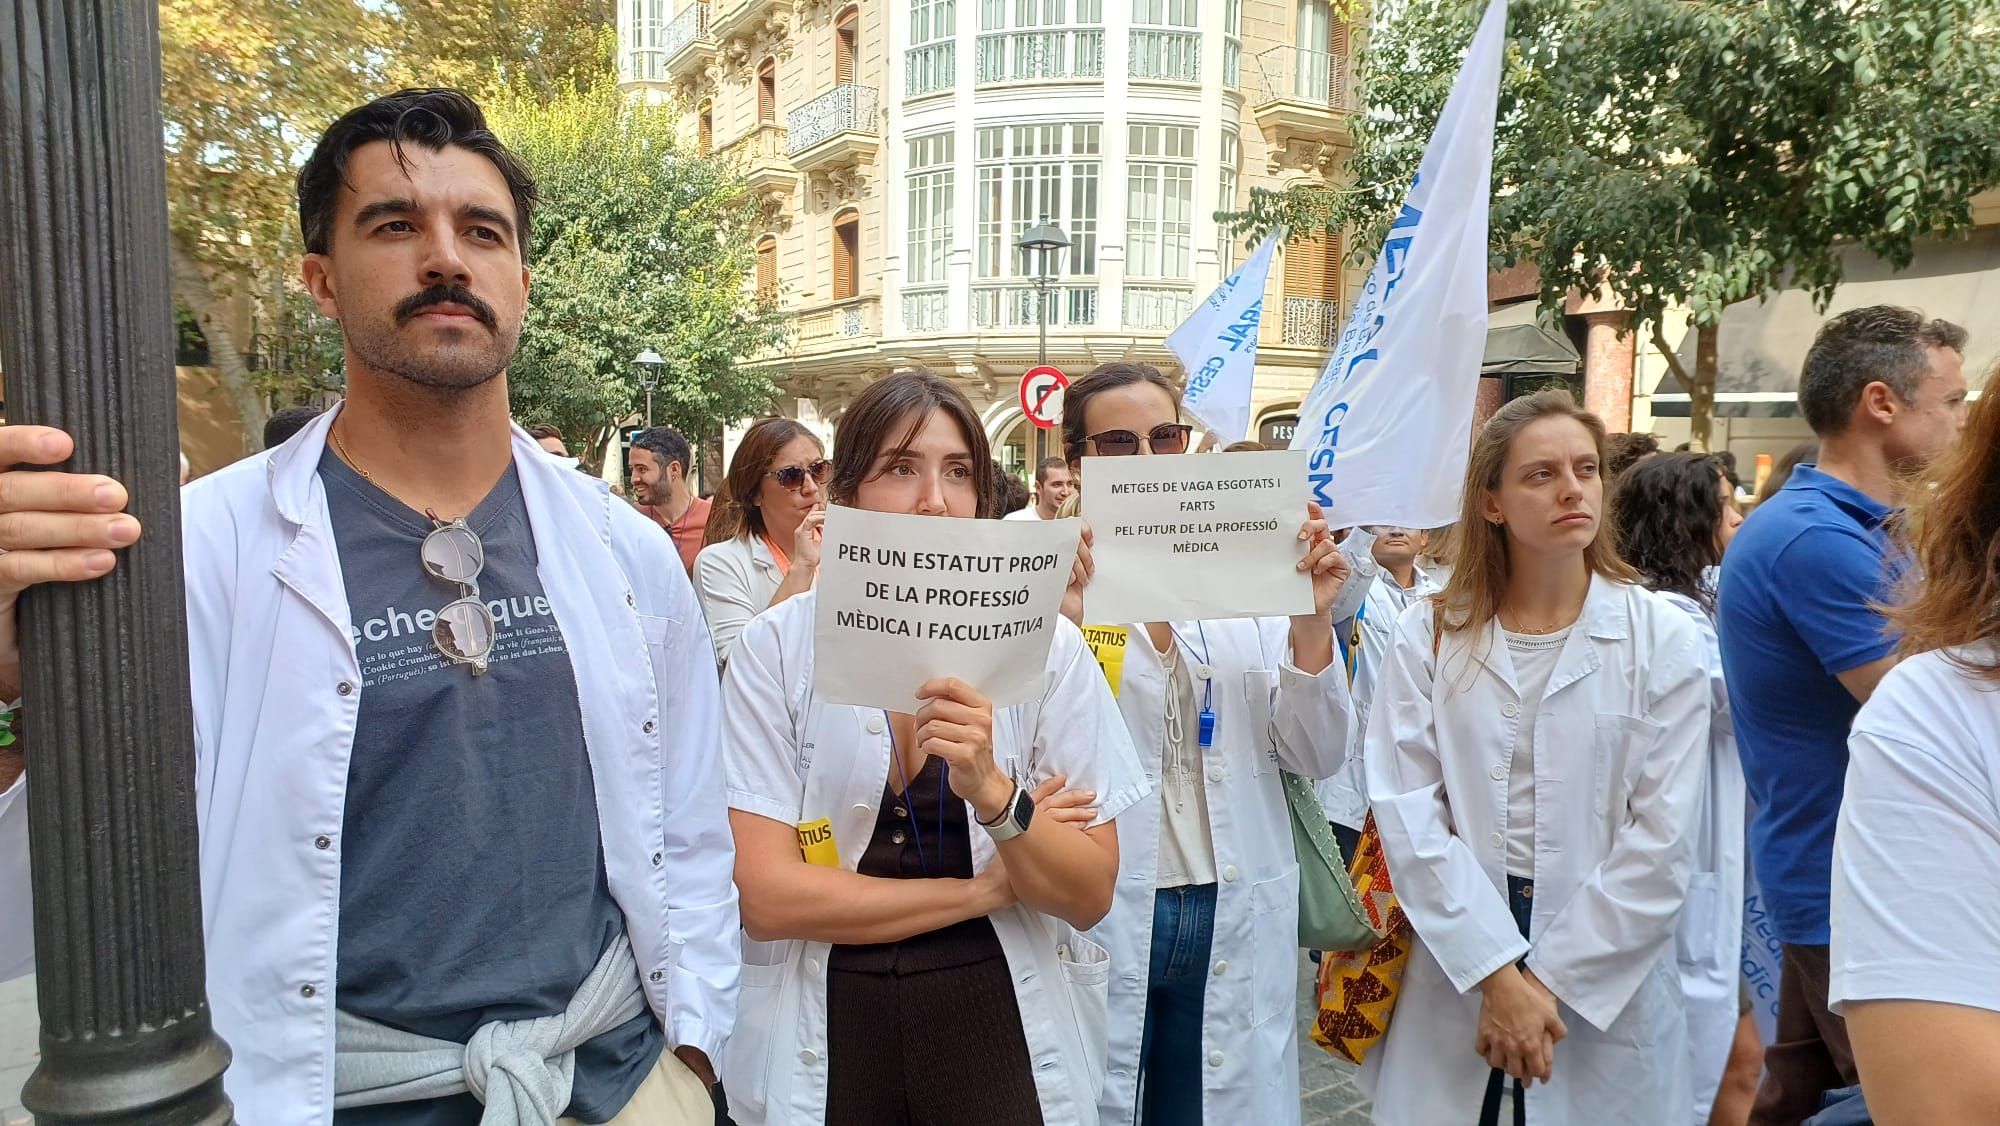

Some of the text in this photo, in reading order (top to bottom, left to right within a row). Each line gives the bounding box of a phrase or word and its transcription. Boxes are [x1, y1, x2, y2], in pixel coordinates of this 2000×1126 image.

[1272, 425, 1298, 440] PES
[1308, 402, 1348, 507] CESM
[1111, 478, 1281, 495] METGES DE VAGA ESGOTATS I
[1180, 500, 1216, 512] FARTS
[1115, 518, 1278, 537] PEL FUTUR DE LA PROFESSIÓ
[838, 543, 1058, 574] PER UN ESTATUT PROPI
[1173, 541, 1219, 553] MÈDICA
[865, 581, 1030, 608] DE LA PROFESSIÓ
[486, 595, 552, 627] que
[837, 609, 1043, 642] MÈDICA I FACULTATIVA
[1081, 628, 1127, 647] LTATIUS
[363, 661, 396, 675] Cookie
[398, 651, 442, 667] Crumbles
[507, 640, 519, 648] vie
[377, 652, 387, 661] lo
[388, 648, 405, 660] que
[406, 645, 423, 654] hay
[494, 632, 514, 641] How
[428, 664, 438, 672] so
[522, 648, 537, 657] das
